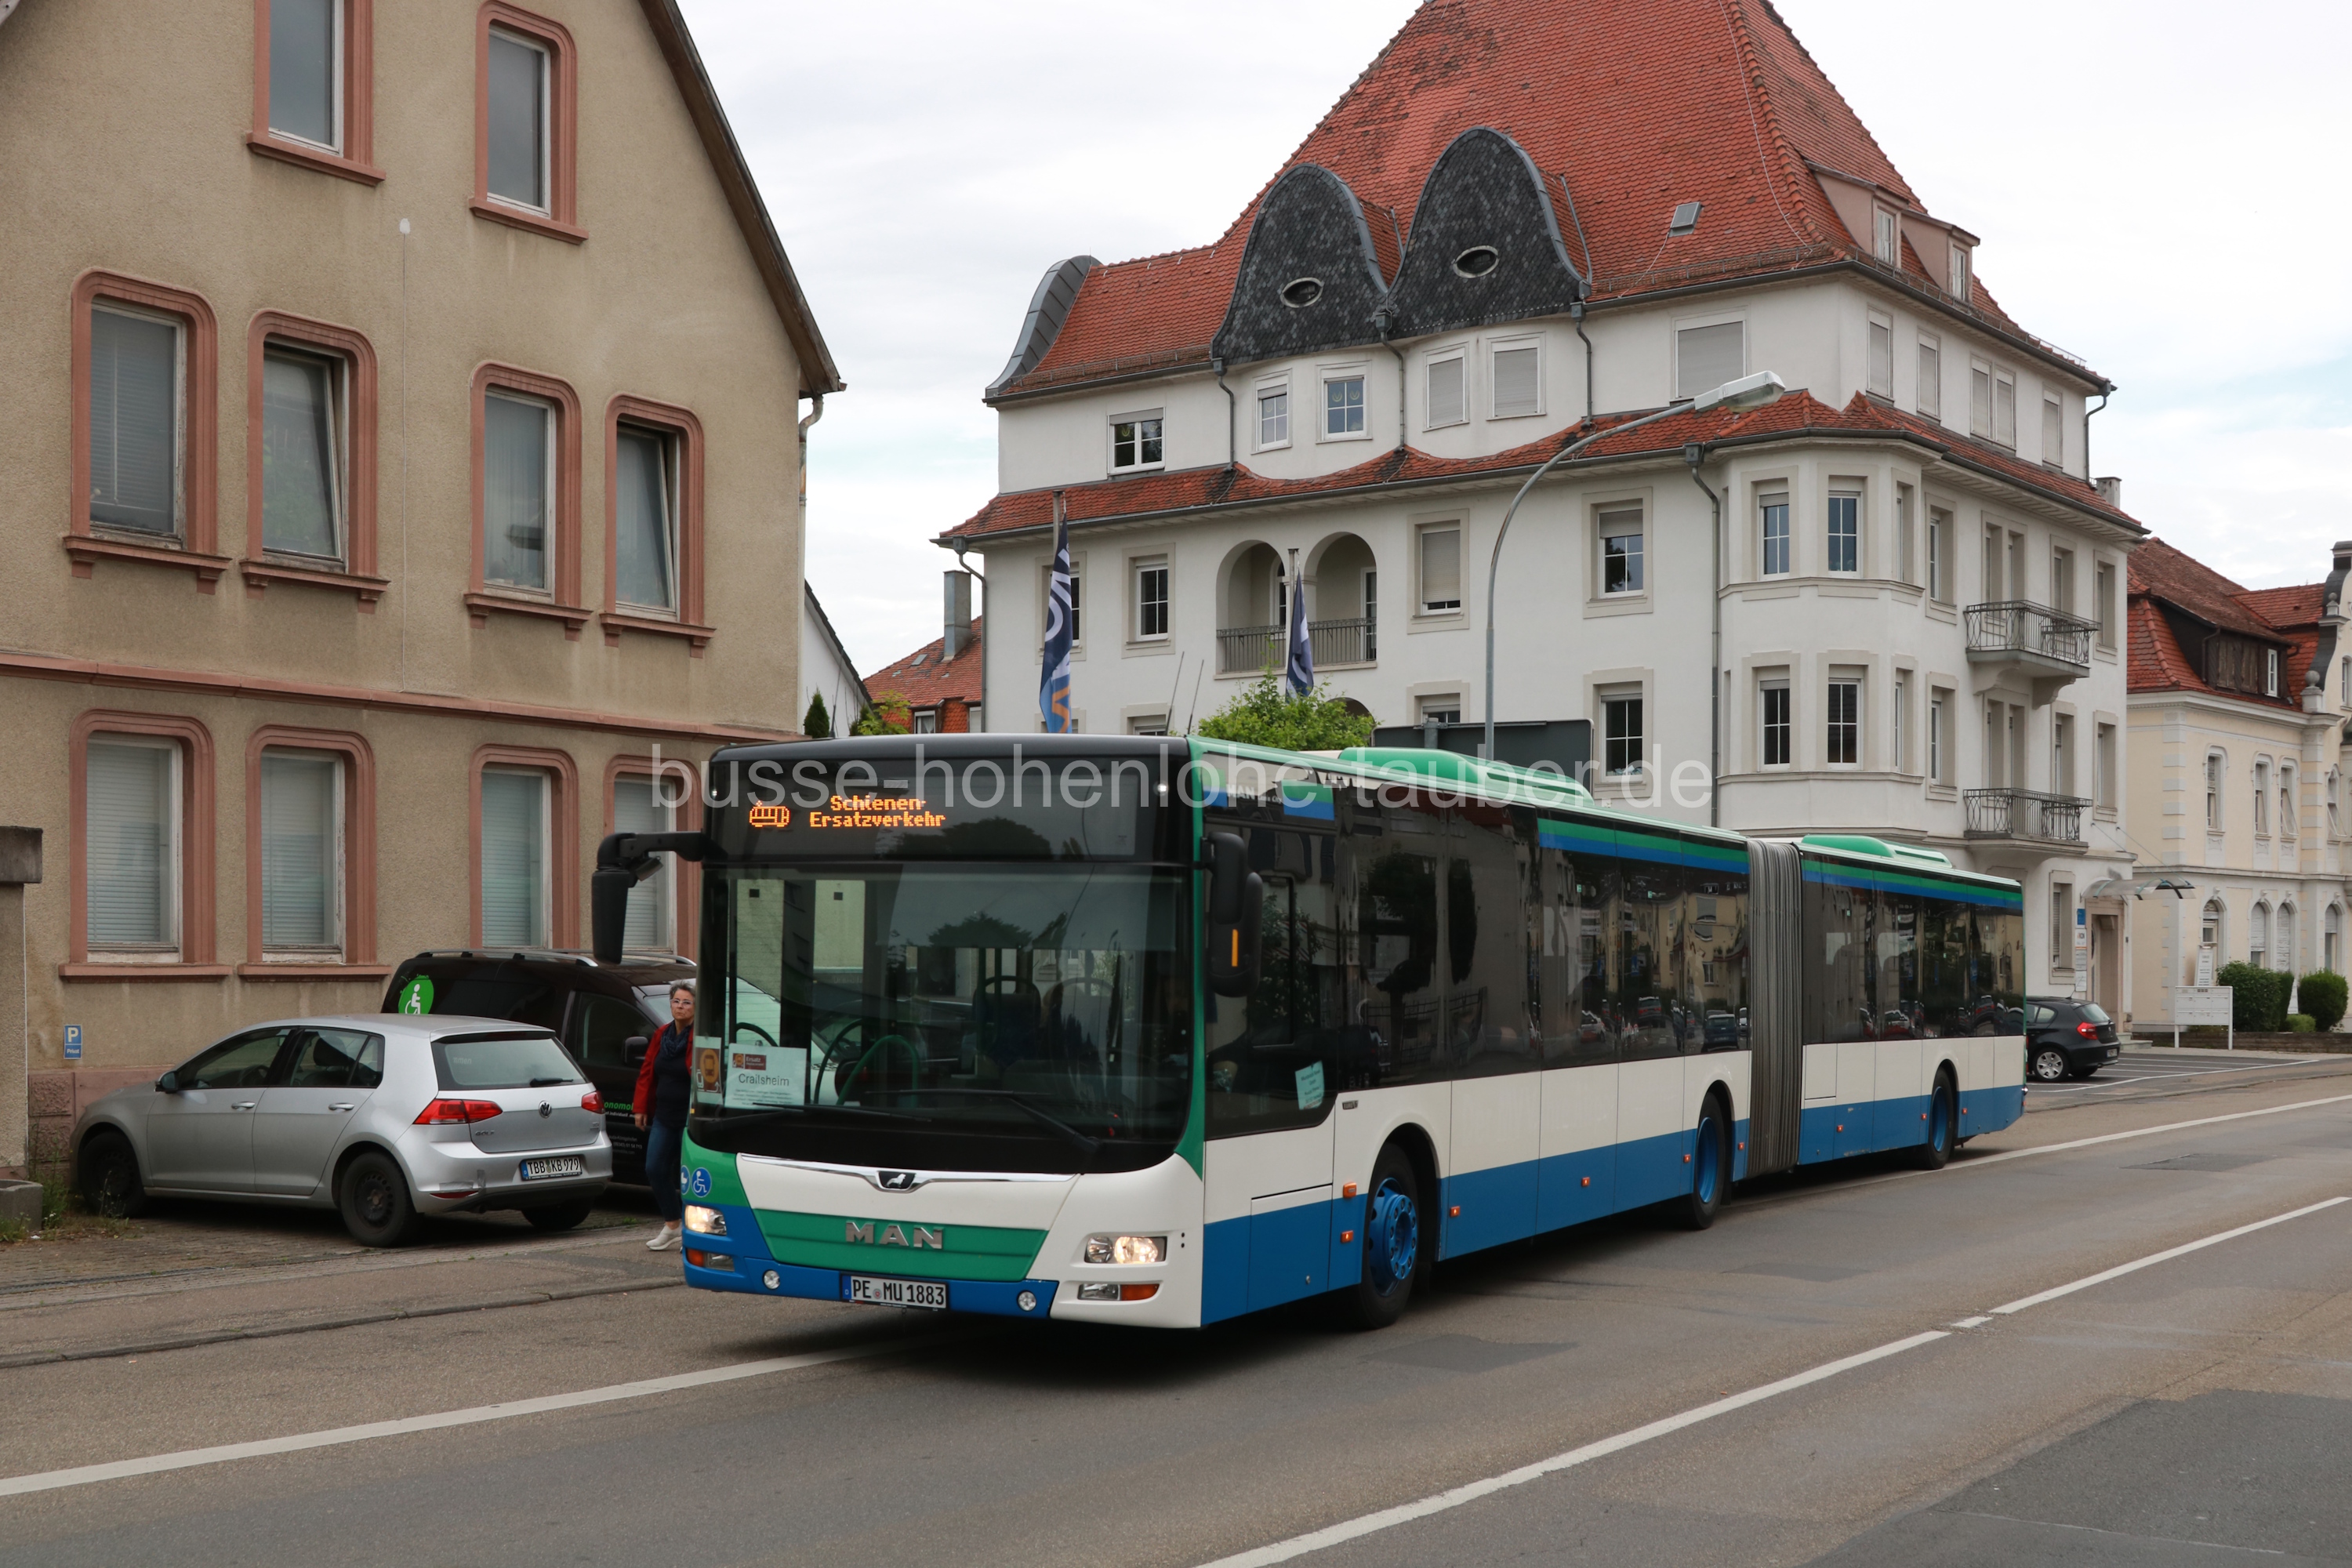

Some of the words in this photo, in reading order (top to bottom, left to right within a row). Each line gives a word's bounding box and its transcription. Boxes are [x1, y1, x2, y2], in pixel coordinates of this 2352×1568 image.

[830, 795, 927, 811] Schienen-
[810, 811, 946, 827] Ersatzverkehr
[67, 1027, 78, 1043] P
[739, 1073, 789, 1087] Crailsheim
[527, 1161, 546, 1174] TBB
[551, 1159, 563, 1172] KB
[564, 1158, 579, 1171] 979
[845, 1221, 943, 1249] MAN
[852, 1279, 872, 1299] PE
[883, 1282, 902, 1301] MU
[906, 1284, 945, 1305] 1883
